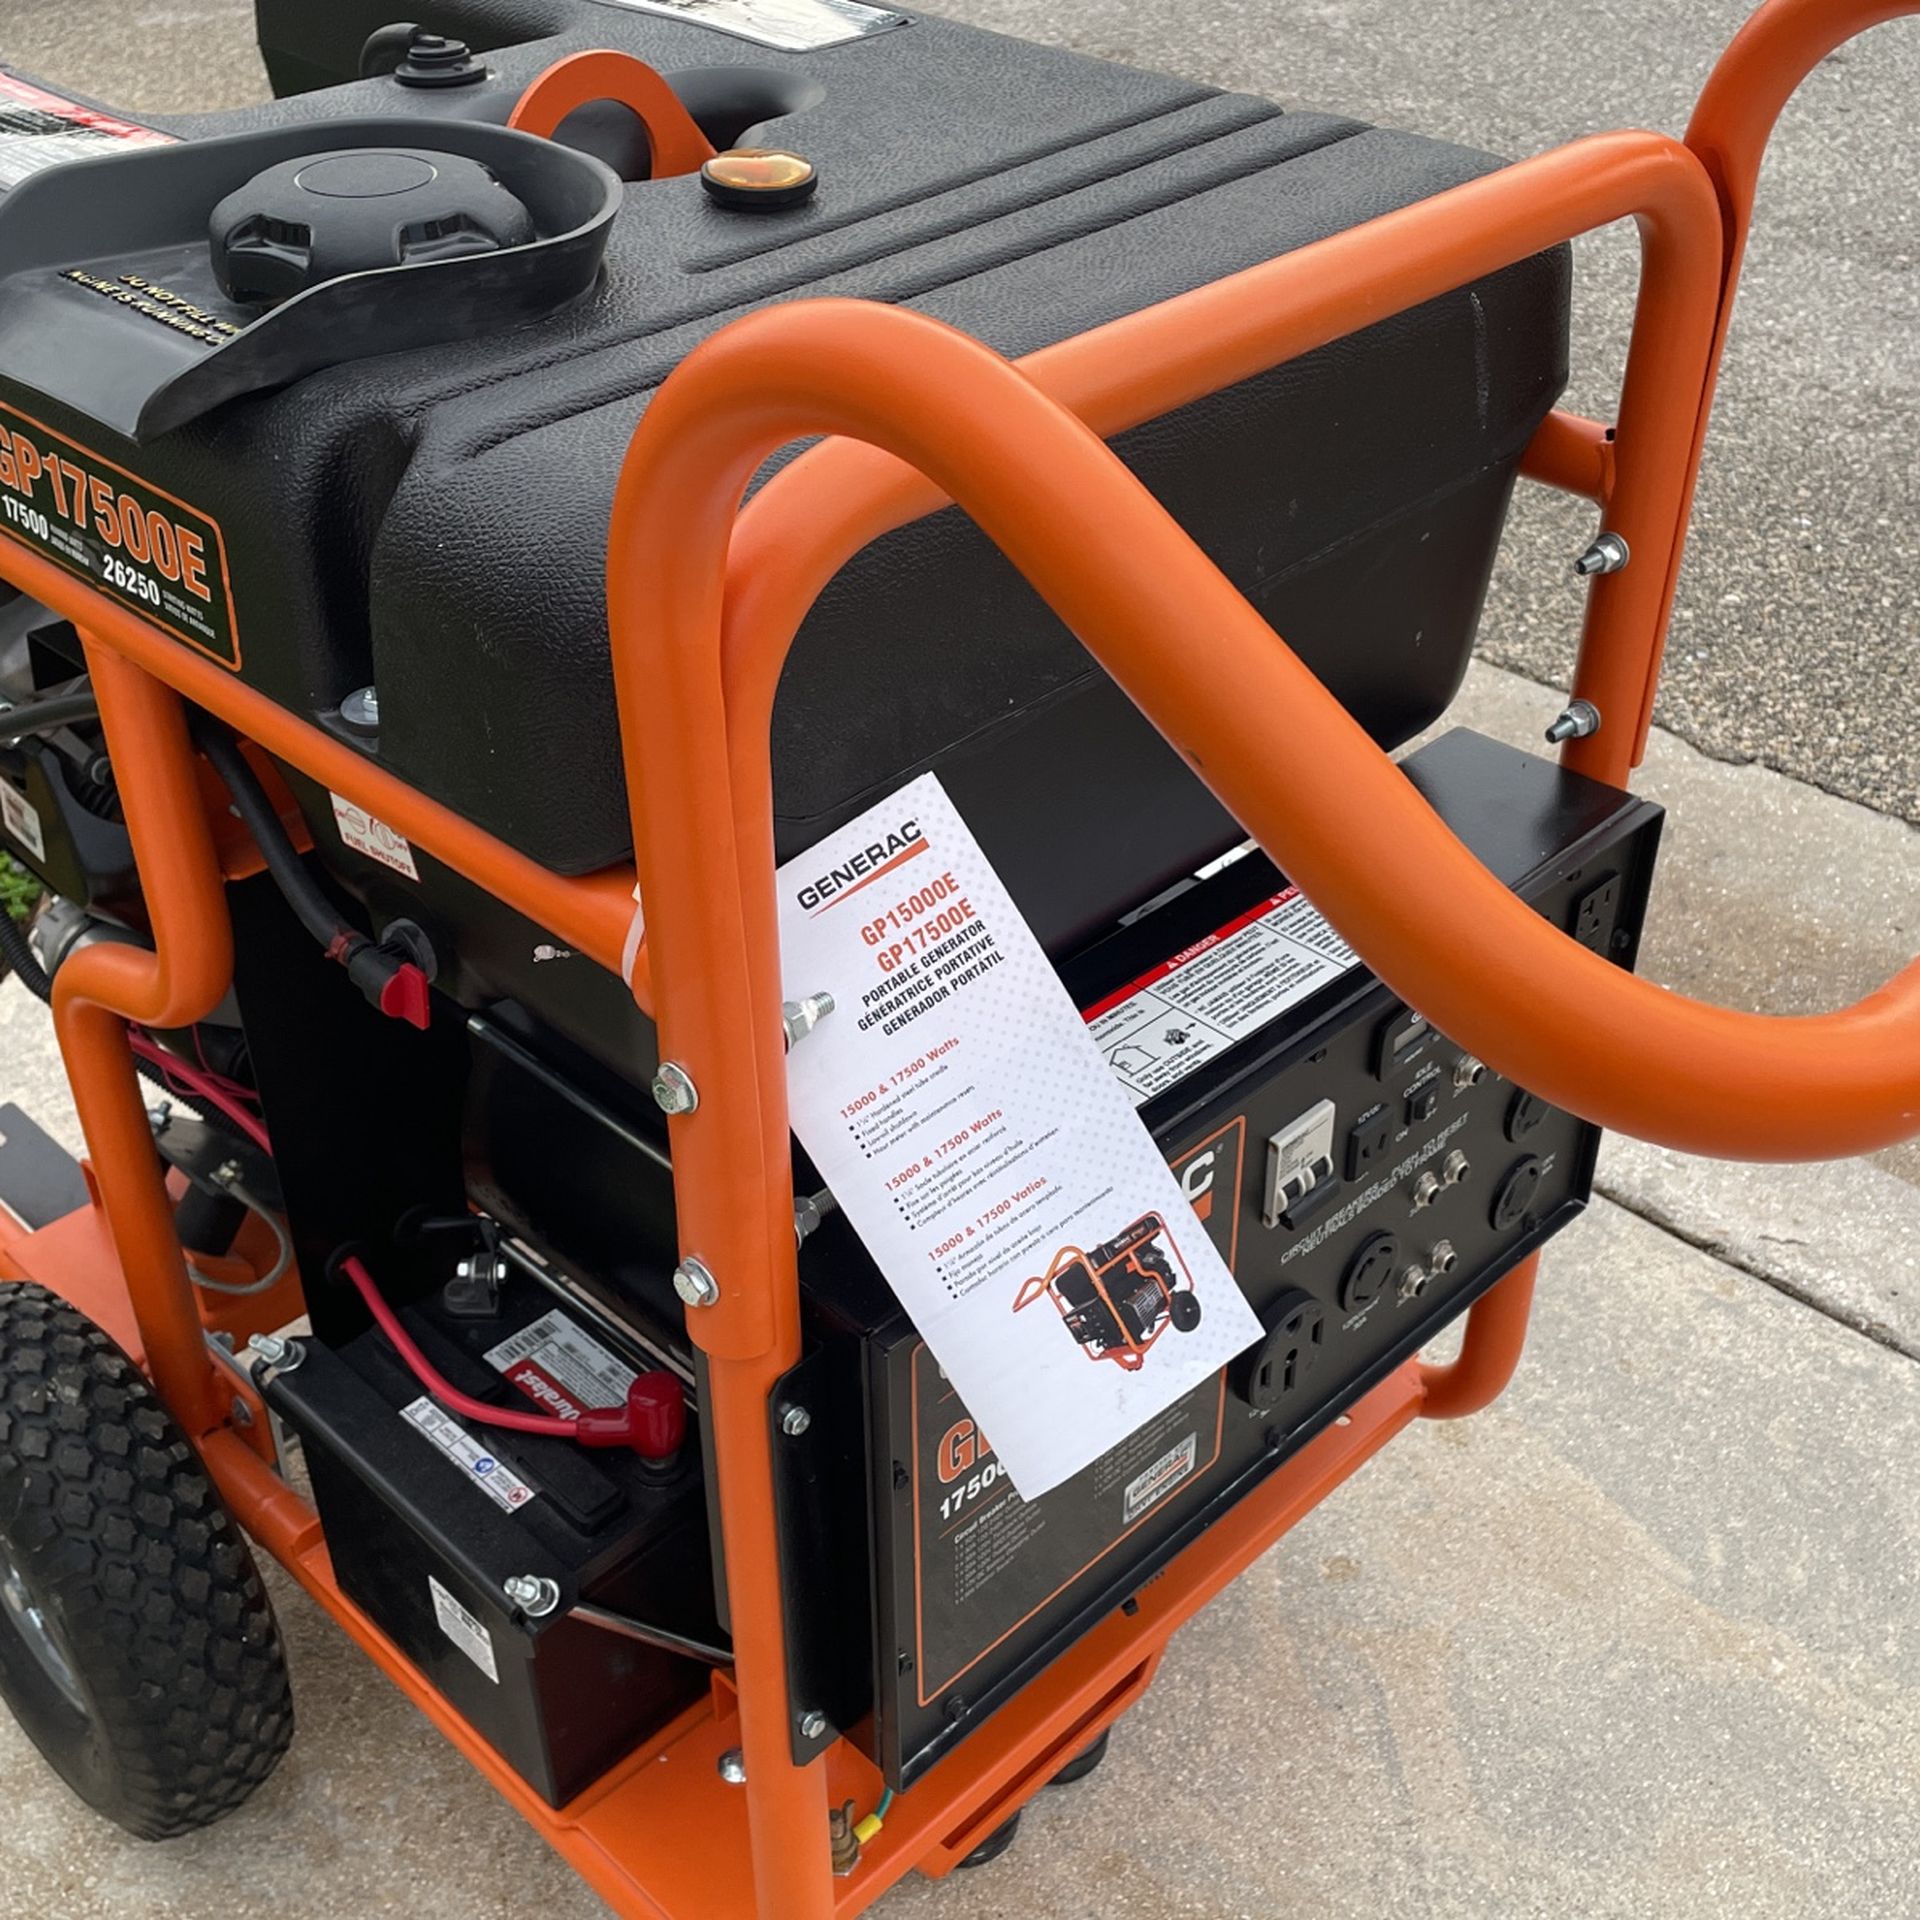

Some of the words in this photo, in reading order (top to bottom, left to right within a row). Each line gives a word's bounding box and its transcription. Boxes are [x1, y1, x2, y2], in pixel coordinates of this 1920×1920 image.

[0, 423, 211, 602] GP17500E
[1, 494, 49, 541] 17500
[103, 553, 160, 607] 26250
[796, 821, 922, 909] GENERAC
[860, 873, 958, 945] GP15000E
[876, 898, 975, 971] GP17500E
[1176, 934, 1221, 962] DANGER
[856, 974, 933, 1029] GÉNÉRATRICE
[935, 935, 994, 978] PORTATIVE
[862, 963, 919, 1005] PORTABLE
[920, 920, 984, 966] GENERATOR
[883, 986, 949, 1034] GENERADOR
[949, 948, 1003, 988] PORTÁTIL
[840, 1090, 876, 1119] 15000
[877, 1083, 888, 1094] &
[890, 1057, 925, 1085] 17500
[926, 1035, 958, 1061] Watts
[1162, 1046, 1190, 1066] OUTSIDE
[1403, 1066, 1441, 1099] CONTROL
[862, 1123, 879, 1136] Fixed
[879, 1107, 902, 1124] handles
[885, 1163, 920, 1191] 15000
[921, 1156, 932, 1166] &
[934, 1130, 969, 1157] 17500
[970, 1108, 1002, 1133] Watts
[928, 1233, 963, 1261] 15000
[964, 1225, 975, 1236] &
[976, 1199, 1011, 1227] 17500
[1011, 1175, 1047, 1202] Vatios
[1280, 1224, 1323, 1265] CIRCUIT
[1325, 1182, 1380, 1230] BREAKERS
[1391, 1152, 1419, 1178] PUSH
[1435, 1111, 1469, 1144] RESET
